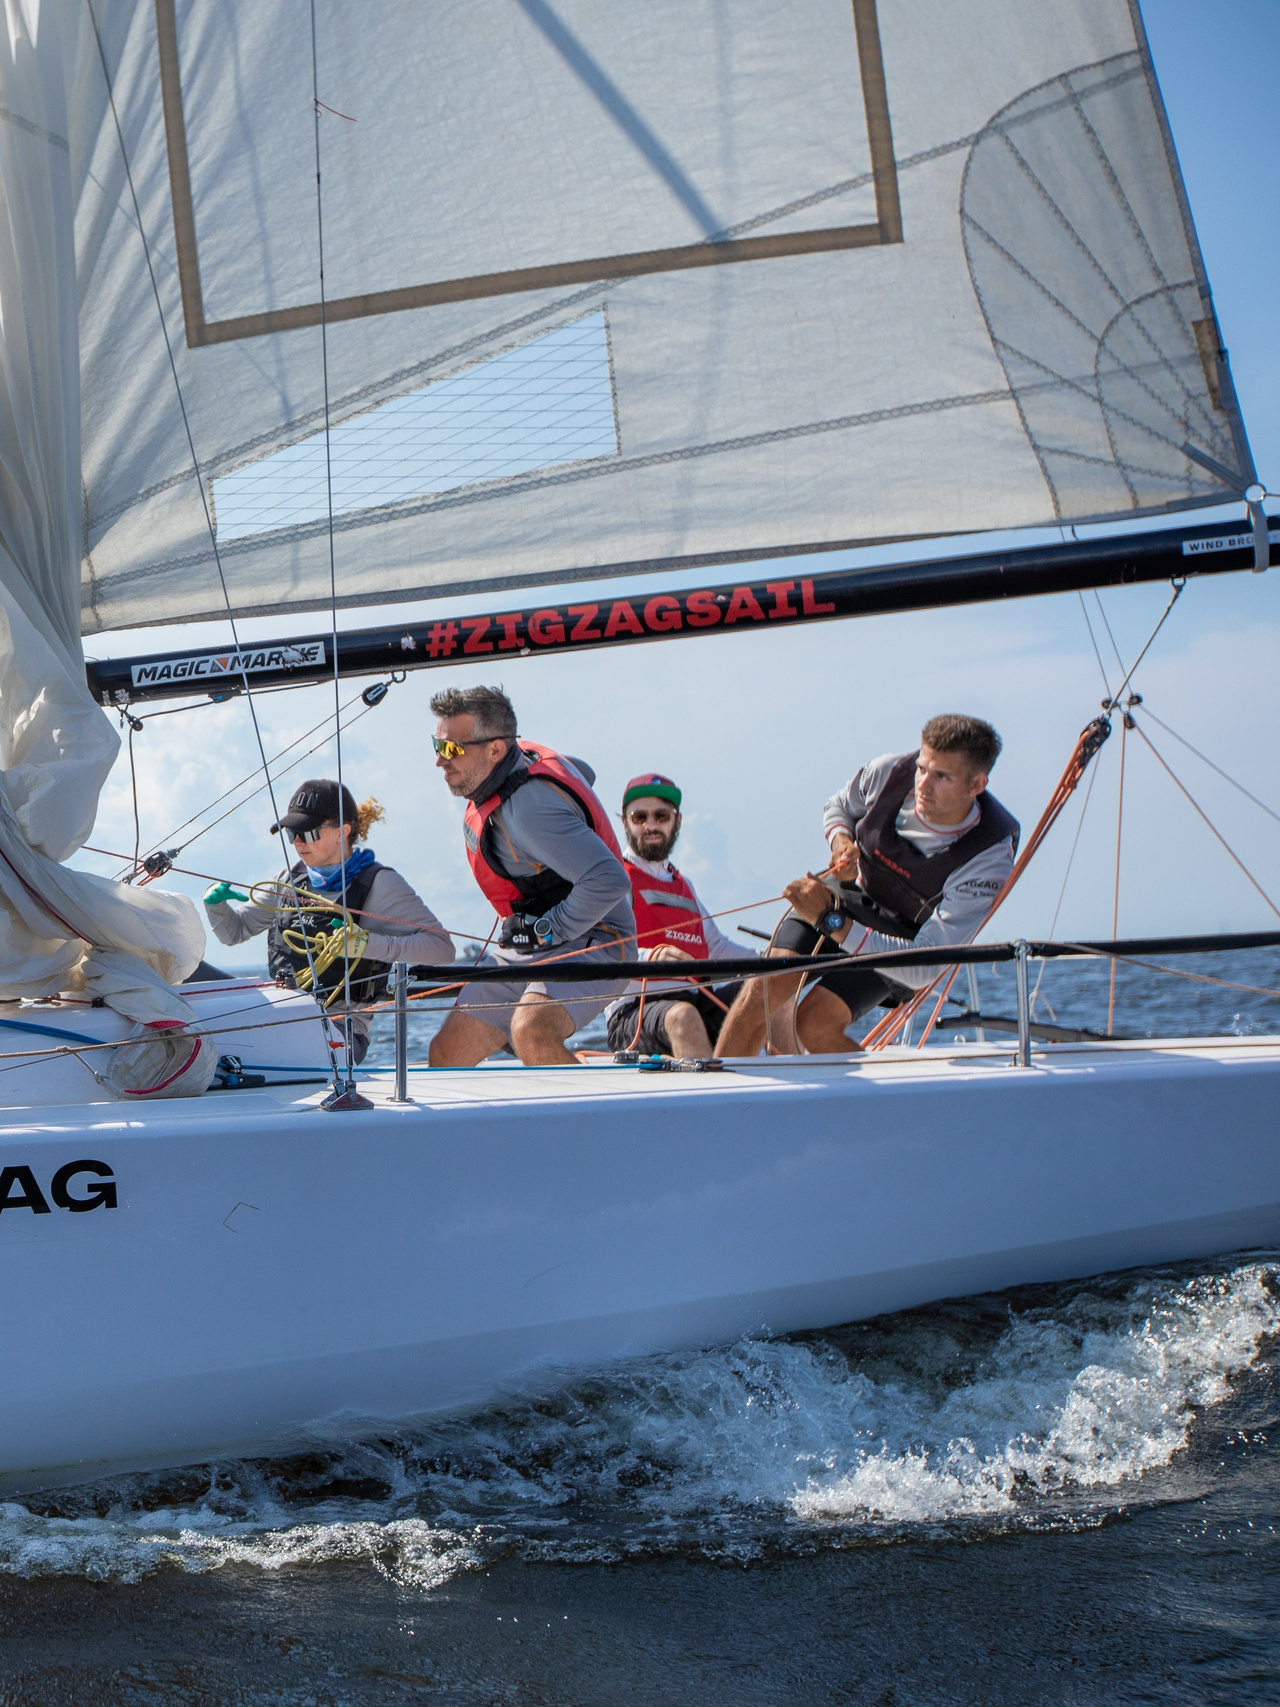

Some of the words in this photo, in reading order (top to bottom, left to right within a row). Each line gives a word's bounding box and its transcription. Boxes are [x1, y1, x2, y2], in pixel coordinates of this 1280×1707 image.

[1189, 541, 1223, 551] WIND
[426, 579, 835, 658] #ZIGZAGSAIL
[136, 659, 210, 683] MAGIC
[229, 645, 321, 671] MARE
[512, 934, 529, 943] Gill
[665, 929, 702, 944] ZIGZAG
